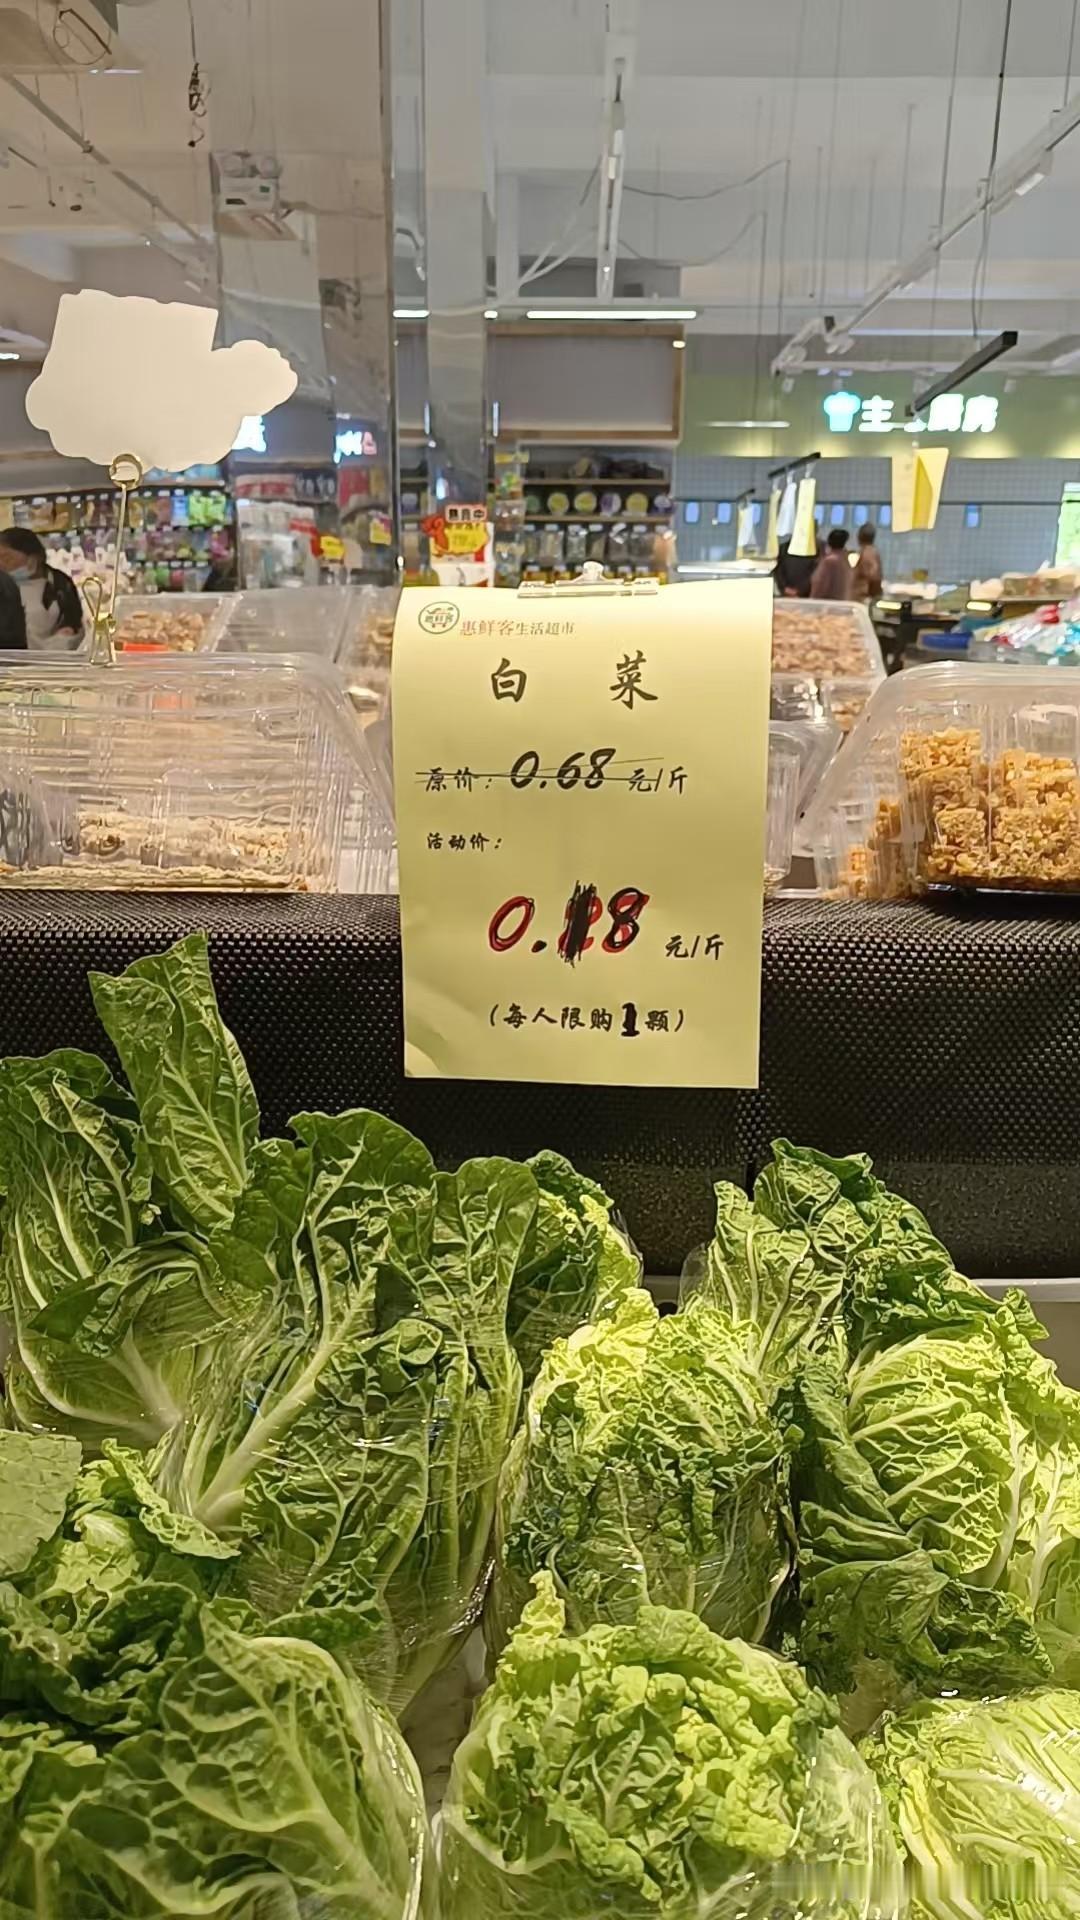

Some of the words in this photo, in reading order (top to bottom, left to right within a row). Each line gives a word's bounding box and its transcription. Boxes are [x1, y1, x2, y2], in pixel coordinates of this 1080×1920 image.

[858, 393, 999, 432] 主厨房
[460, 619, 576, 637] 惠鲜客生活超市
[510, 748, 617, 790] 0.68
[426, 832, 503, 853] 活动价：
[665, 934, 725, 960] 元/斤
[489, 1002, 685, 1037] （每人限购1颗）
